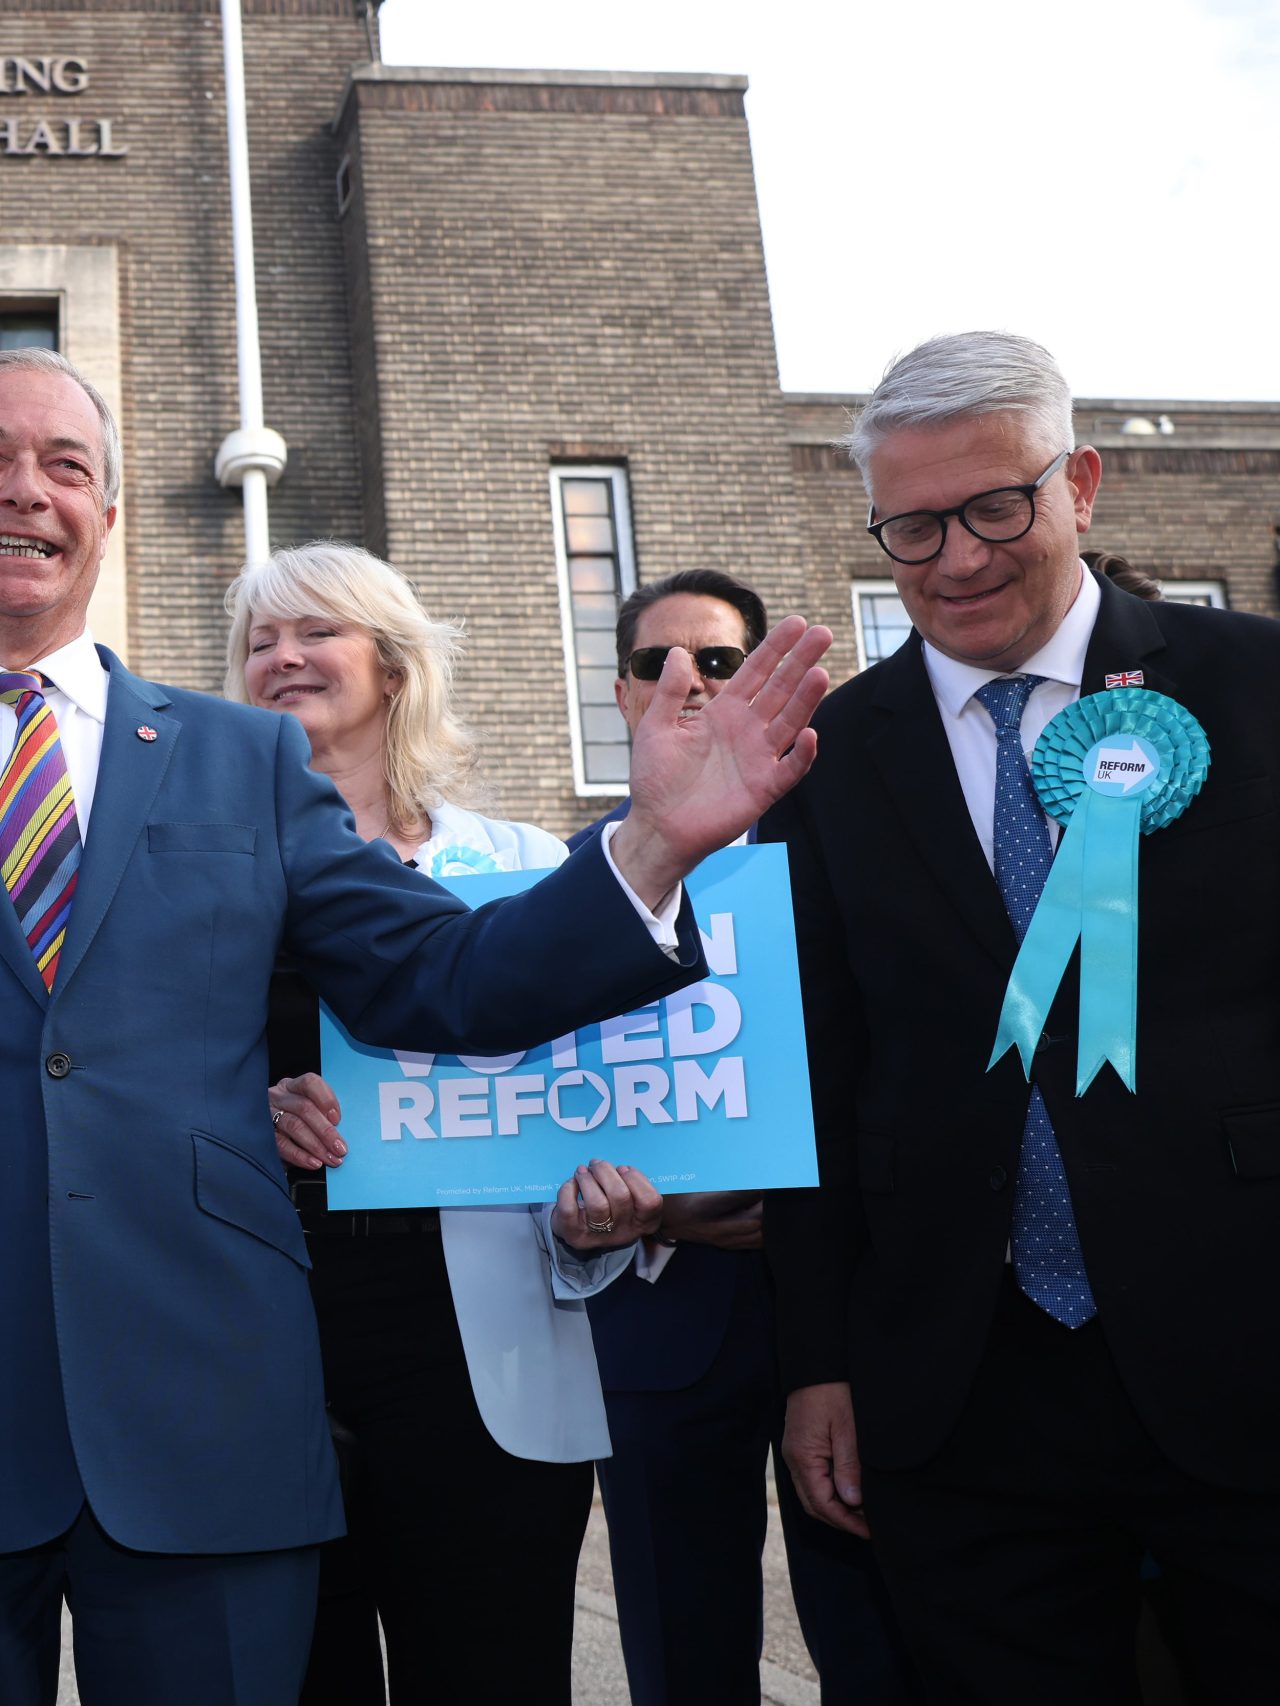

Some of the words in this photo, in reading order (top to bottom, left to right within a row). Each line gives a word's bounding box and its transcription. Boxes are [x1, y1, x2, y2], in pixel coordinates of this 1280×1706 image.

[1099, 760, 1145, 772] REFORM
[1097, 770, 1112, 780] UK
[378, 1056, 748, 1141] REFORM
